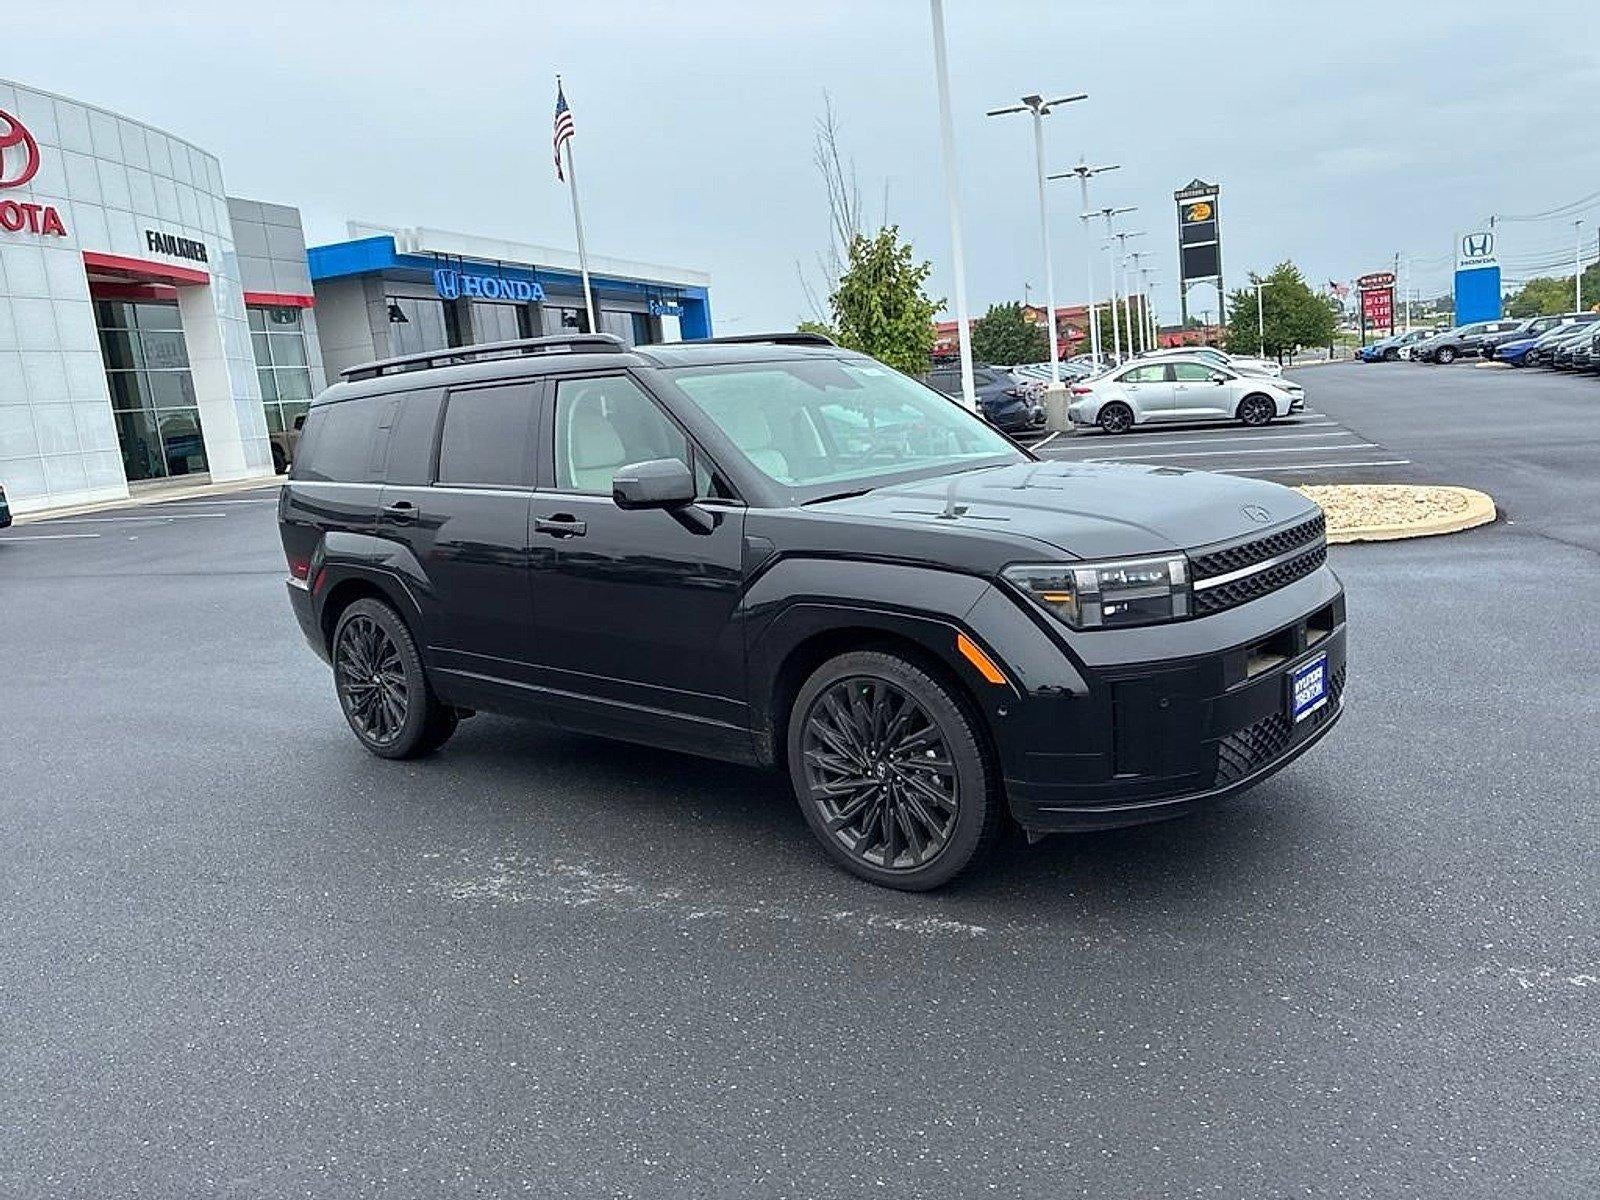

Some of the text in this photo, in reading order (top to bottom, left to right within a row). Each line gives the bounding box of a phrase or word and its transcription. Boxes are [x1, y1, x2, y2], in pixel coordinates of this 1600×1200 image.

[145, 229, 208, 263] FAULKNER
[1460, 257, 1497, 266] HONDA
[460, 275, 547, 301] HONDA
